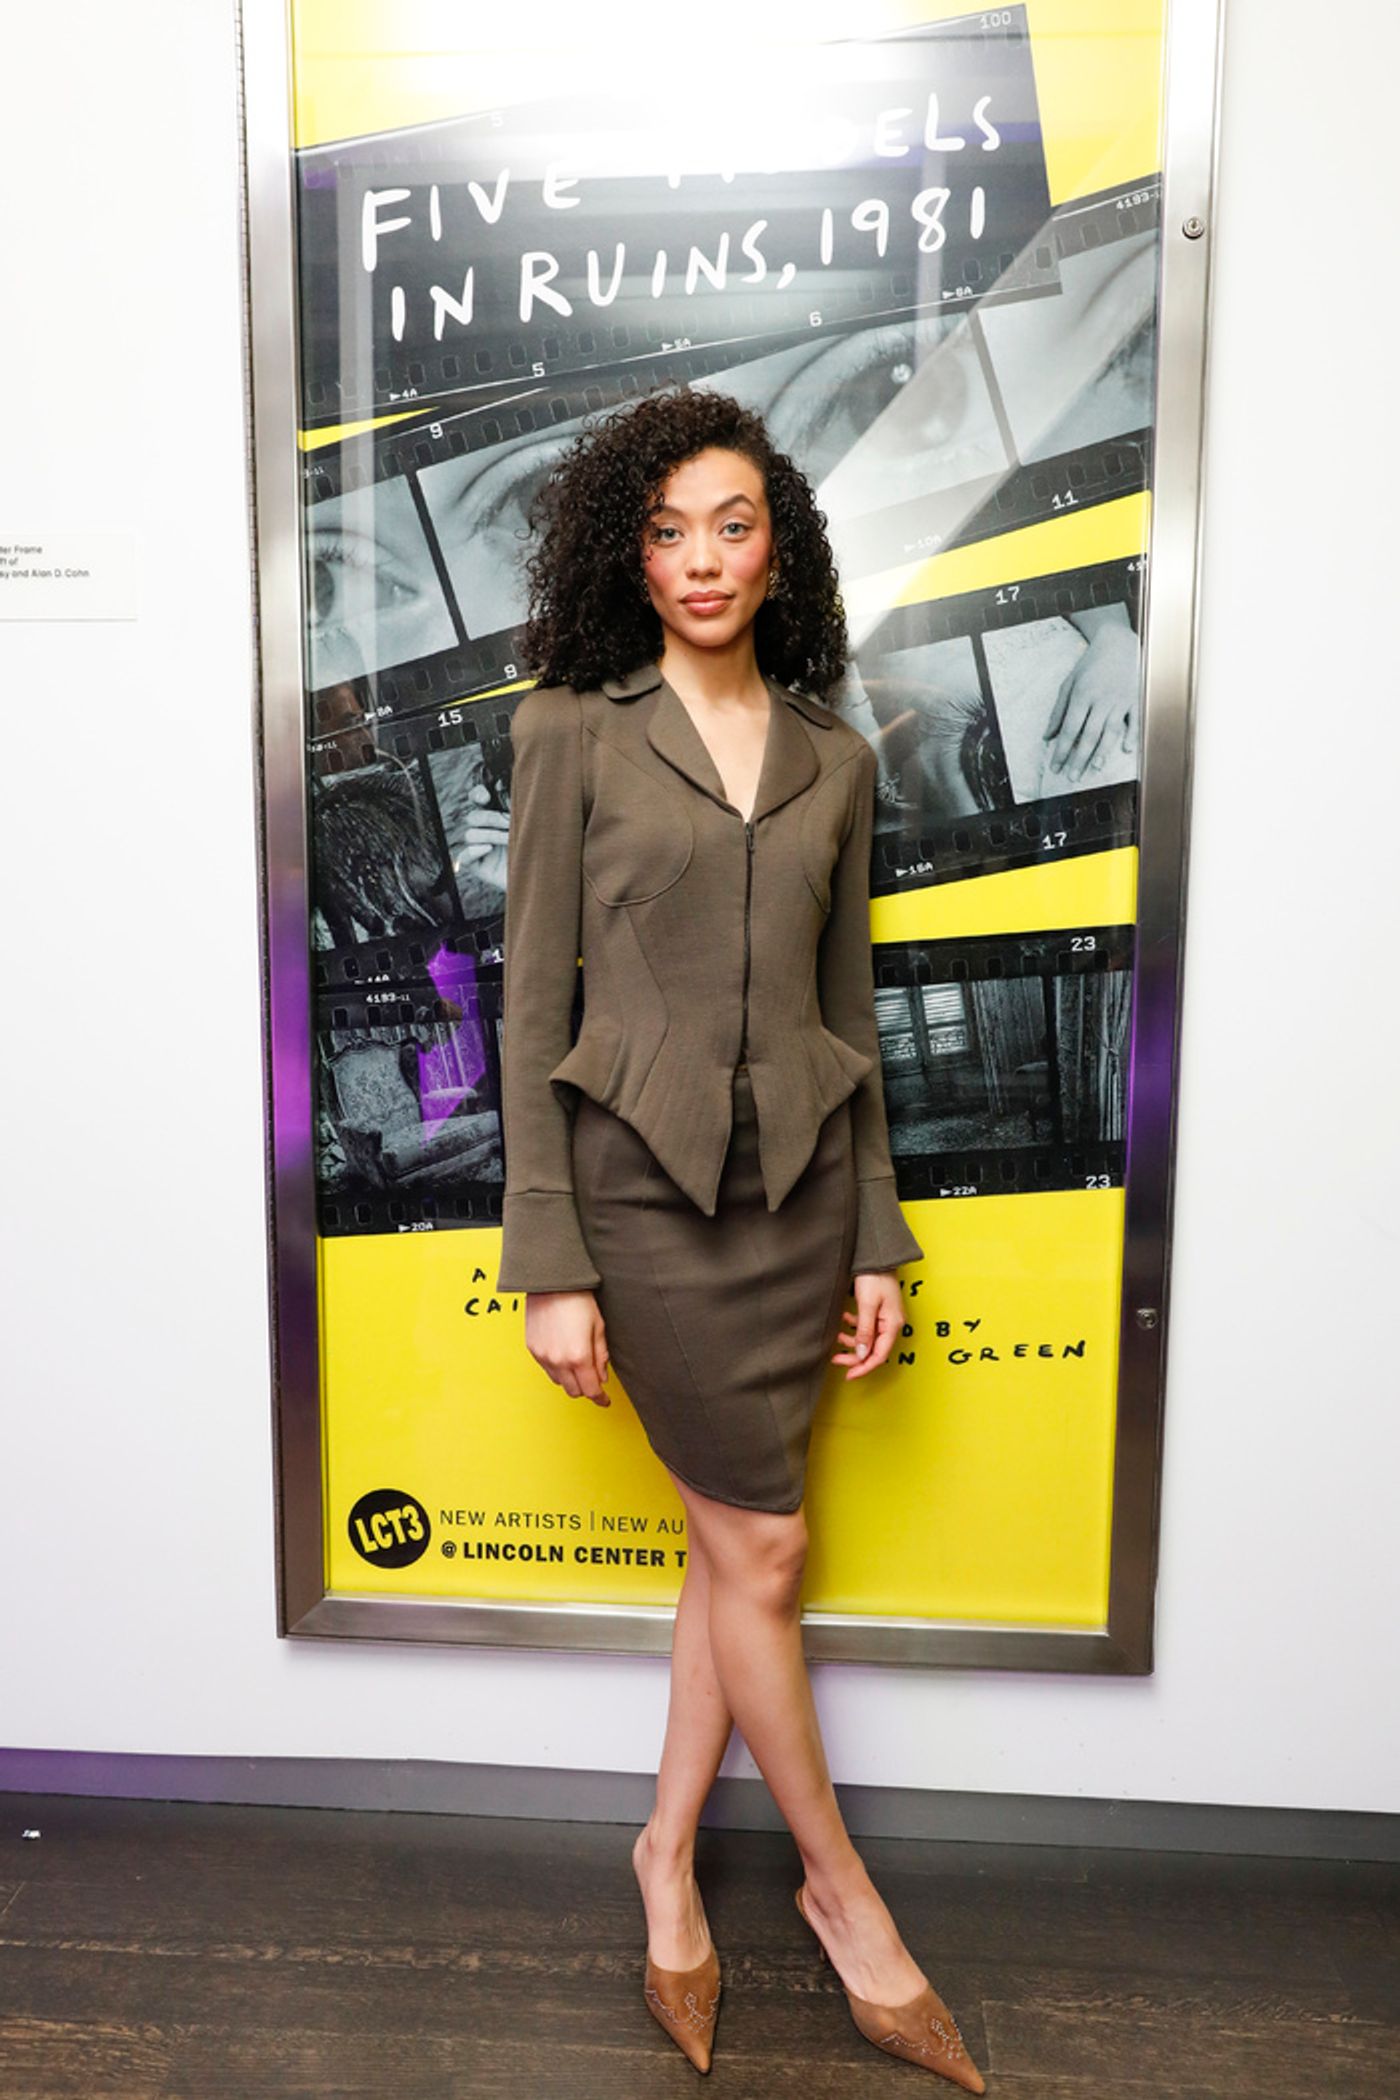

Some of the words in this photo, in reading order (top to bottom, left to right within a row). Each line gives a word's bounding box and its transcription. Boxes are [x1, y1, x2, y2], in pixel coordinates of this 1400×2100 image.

[980, 11, 1012, 29] 100
[362, 162, 582, 272] FIVE
[391, 266, 474, 341] IN
[519, 219, 797, 323] RUINS,
[820, 186, 985, 265] 1981
[532, 362, 545, 378] 5
[430, 422, 443, 440] 9
[1052, 490, 1078, 510] 11
[14, 545, 43, 555] Frame
[12, 569, 29, 578] and
[31, 569, 52, 578] Alan
[995, 586, 1021, 606] 17
[438, 709, 463, 728] 15
[1042, 831, 1067, 850] 17
[1071, 936, 1096, 952] 23
[952, 1185, 977, 1196] 22A
[1085, 1174, 1111, 1190] 23
[411, 1221, 434, 1232] 20A
[464, 1297, 519, 1316] CAI
[935, 1318, 981, 1338] BY
[948, 1340, 1086, 1365] GREEN
[354, 1503, 425, 1554] LCT3
[440, 1510, 486, 1526] NEW
[494, 1511, 582, 1530] ARTISTS
[602, 1515, 649, 1533] NEW
[441, 1541, 457, 1559] @
[463, 1542, 564, 1563] LINCOLN
[573, 1546, 666, 1566] CENTER
